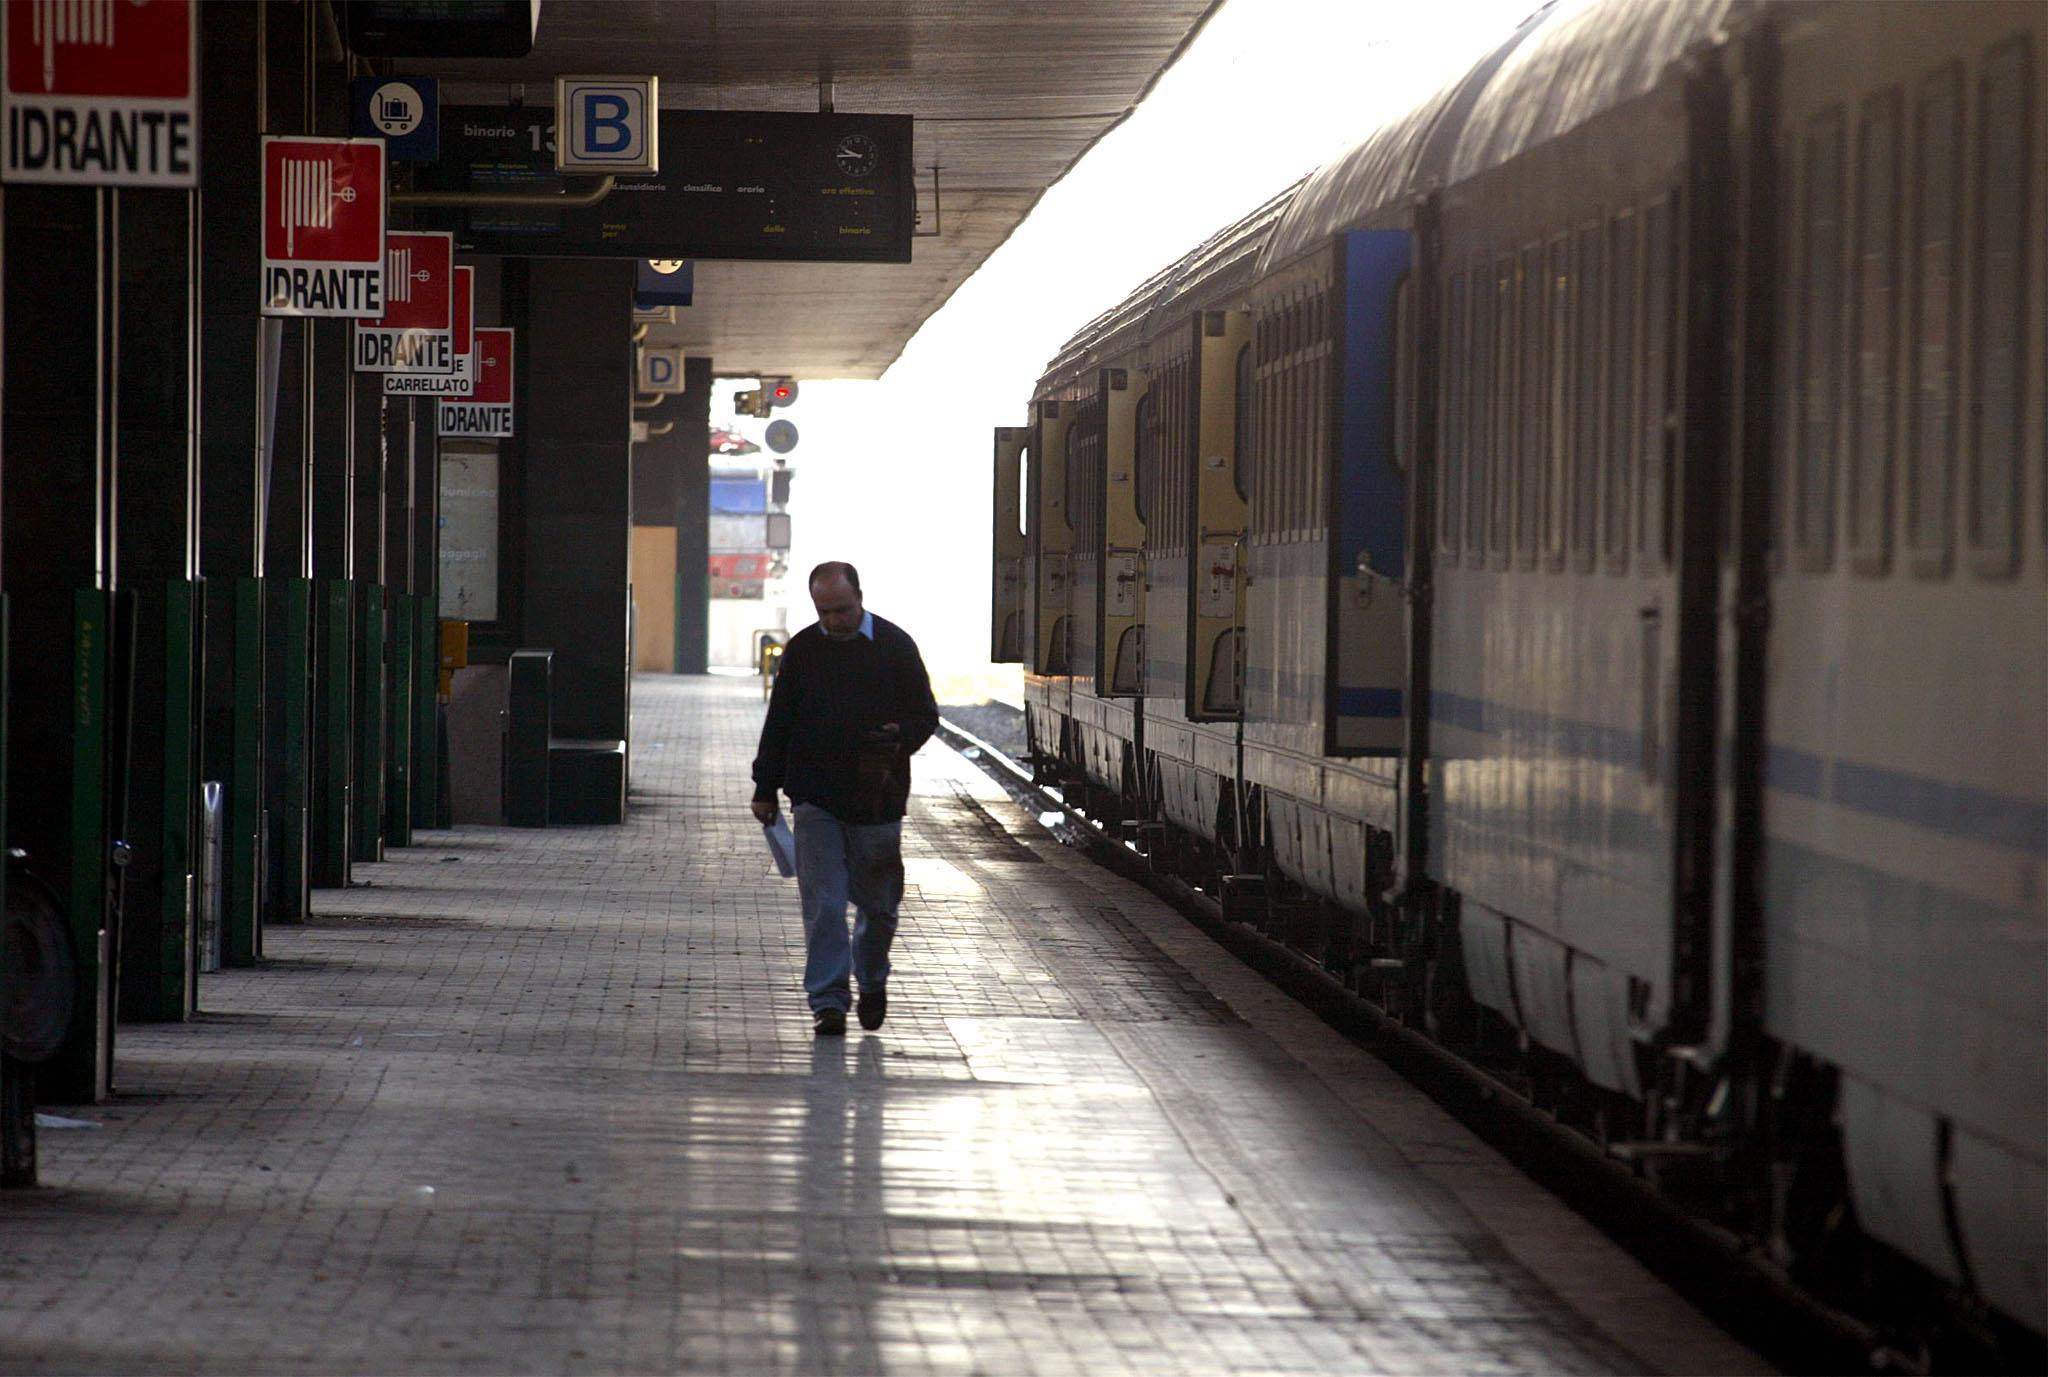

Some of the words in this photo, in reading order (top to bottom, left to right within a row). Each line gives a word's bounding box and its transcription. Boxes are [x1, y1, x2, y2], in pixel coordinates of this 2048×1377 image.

[464, 124, 516, 138] binario
[584, 94, 632, 153] B
[8, 108, 190, 175] IDRANTE
[265, 268, 380, 311] IDRANTE
[357, 336, 449, 368] IDRANTE
[651, 357, 672, 383] D
[385, 378, 469, 392] CARRELLATO
[440, 407, 511, 433] IDRANTE
